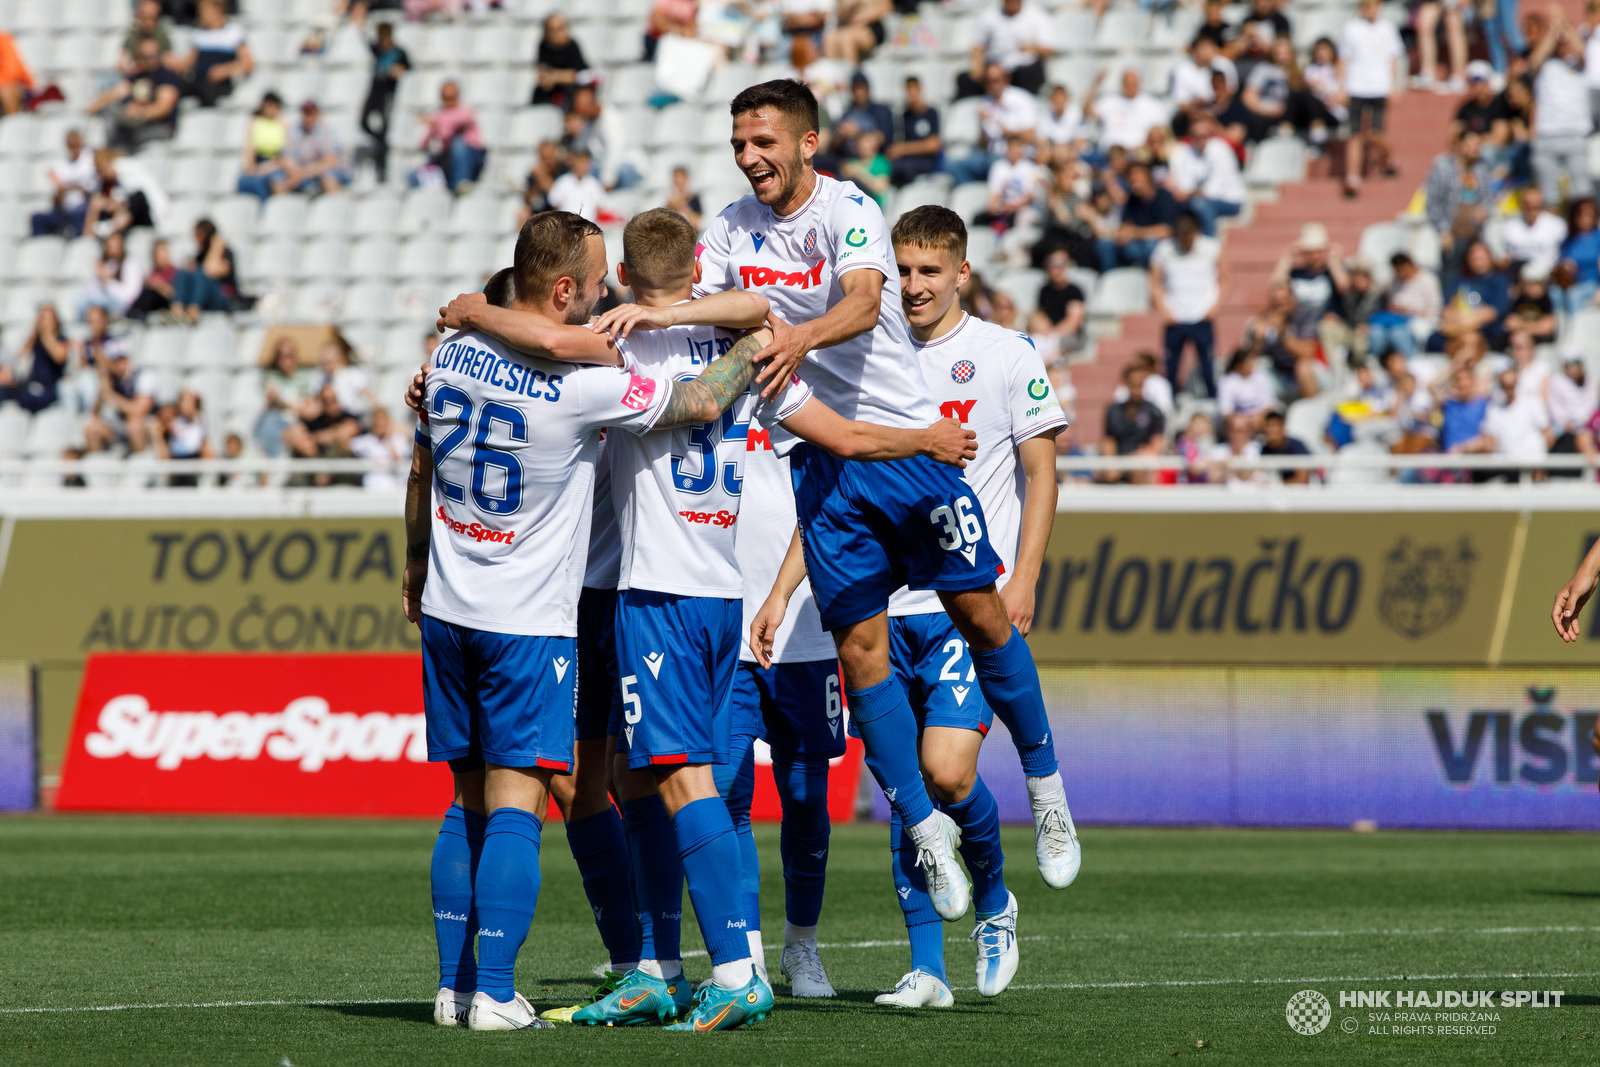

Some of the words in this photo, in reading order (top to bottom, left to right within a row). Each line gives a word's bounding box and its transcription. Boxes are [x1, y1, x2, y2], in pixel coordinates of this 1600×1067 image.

[739, 258, 827, 290] TOMMY
[436, 342, 564, 403] LOVRENCSICS
[431, 382, 529, 517] 26
[930, 495, 982, 551] 36
[149, 530, 396, 583] TOYOTA
[82, 604, 221, 650] AUTO
[621, 674, 643, 725] 5
[825, 673, 842, 719] 6
